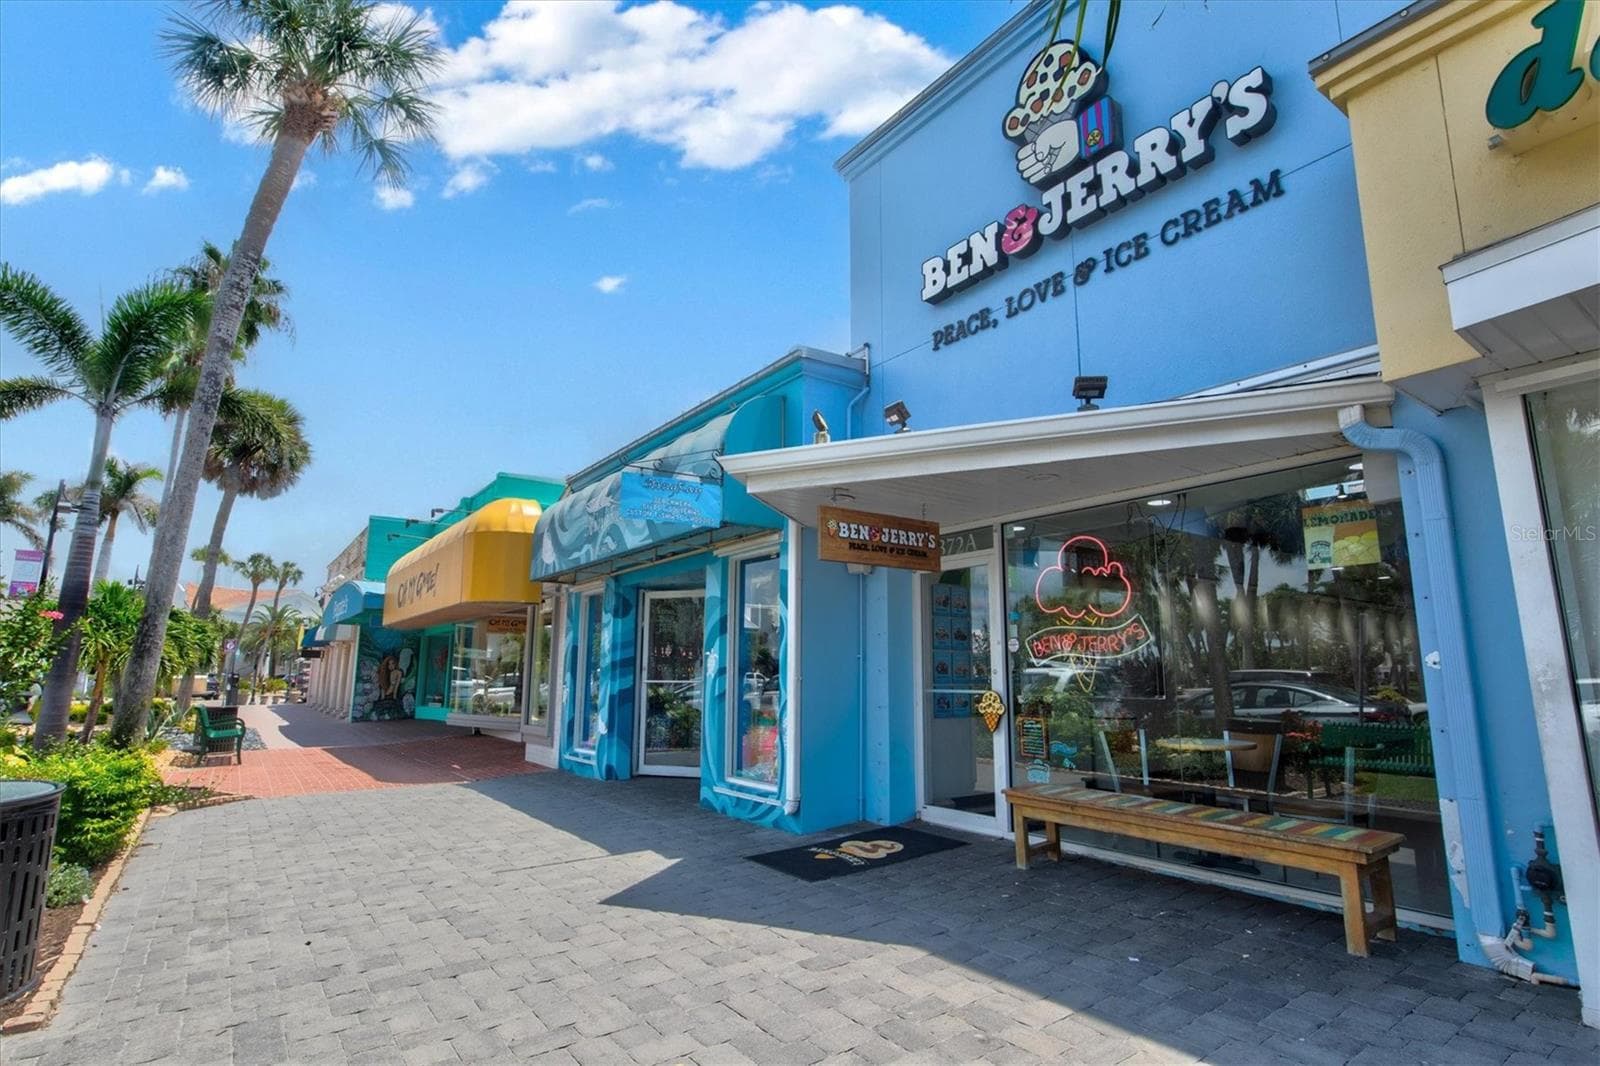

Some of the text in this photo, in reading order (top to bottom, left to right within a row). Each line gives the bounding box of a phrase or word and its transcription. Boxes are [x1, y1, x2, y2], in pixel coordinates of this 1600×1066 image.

[932, 168, 1286, 351] PEACE, LOVE & ICE CREAM
[1303, 508, 1378, 528] LEMONADE
